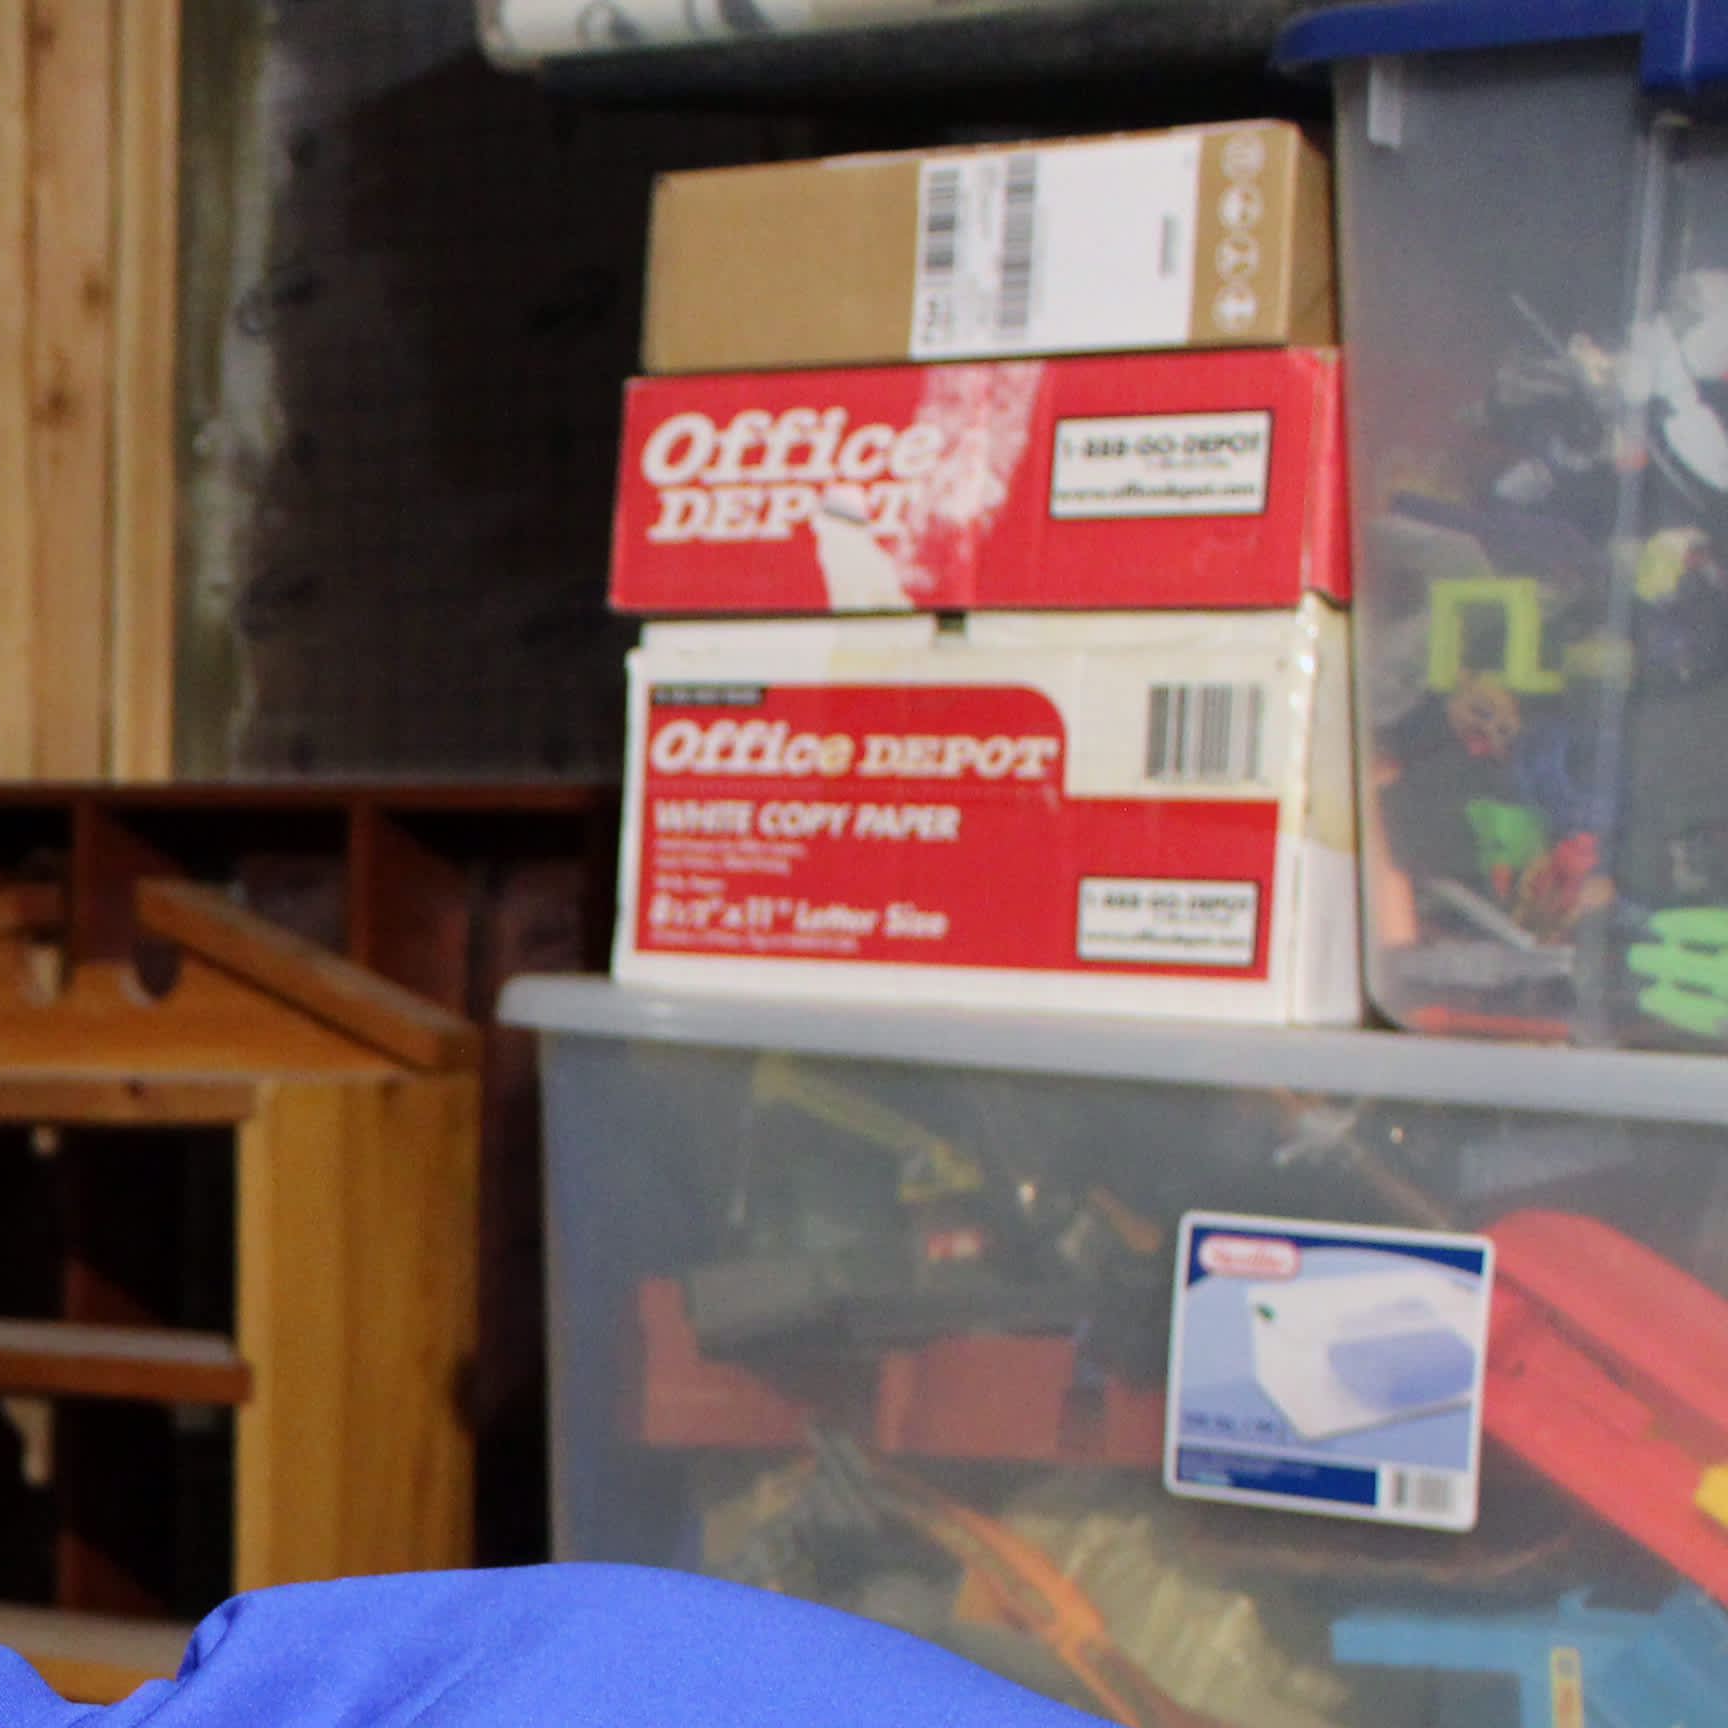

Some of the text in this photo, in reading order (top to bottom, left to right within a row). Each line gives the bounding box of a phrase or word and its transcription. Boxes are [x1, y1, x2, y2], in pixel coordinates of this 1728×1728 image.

[640, 406, 941, 486] Office
[647, 483, 927, 543] DEPT
[649, 719, 1058, 780] Office DEPOT
[653, 799, 961, 841] WHITE COPY PAPER
[883, 902, 949, 939] Size
